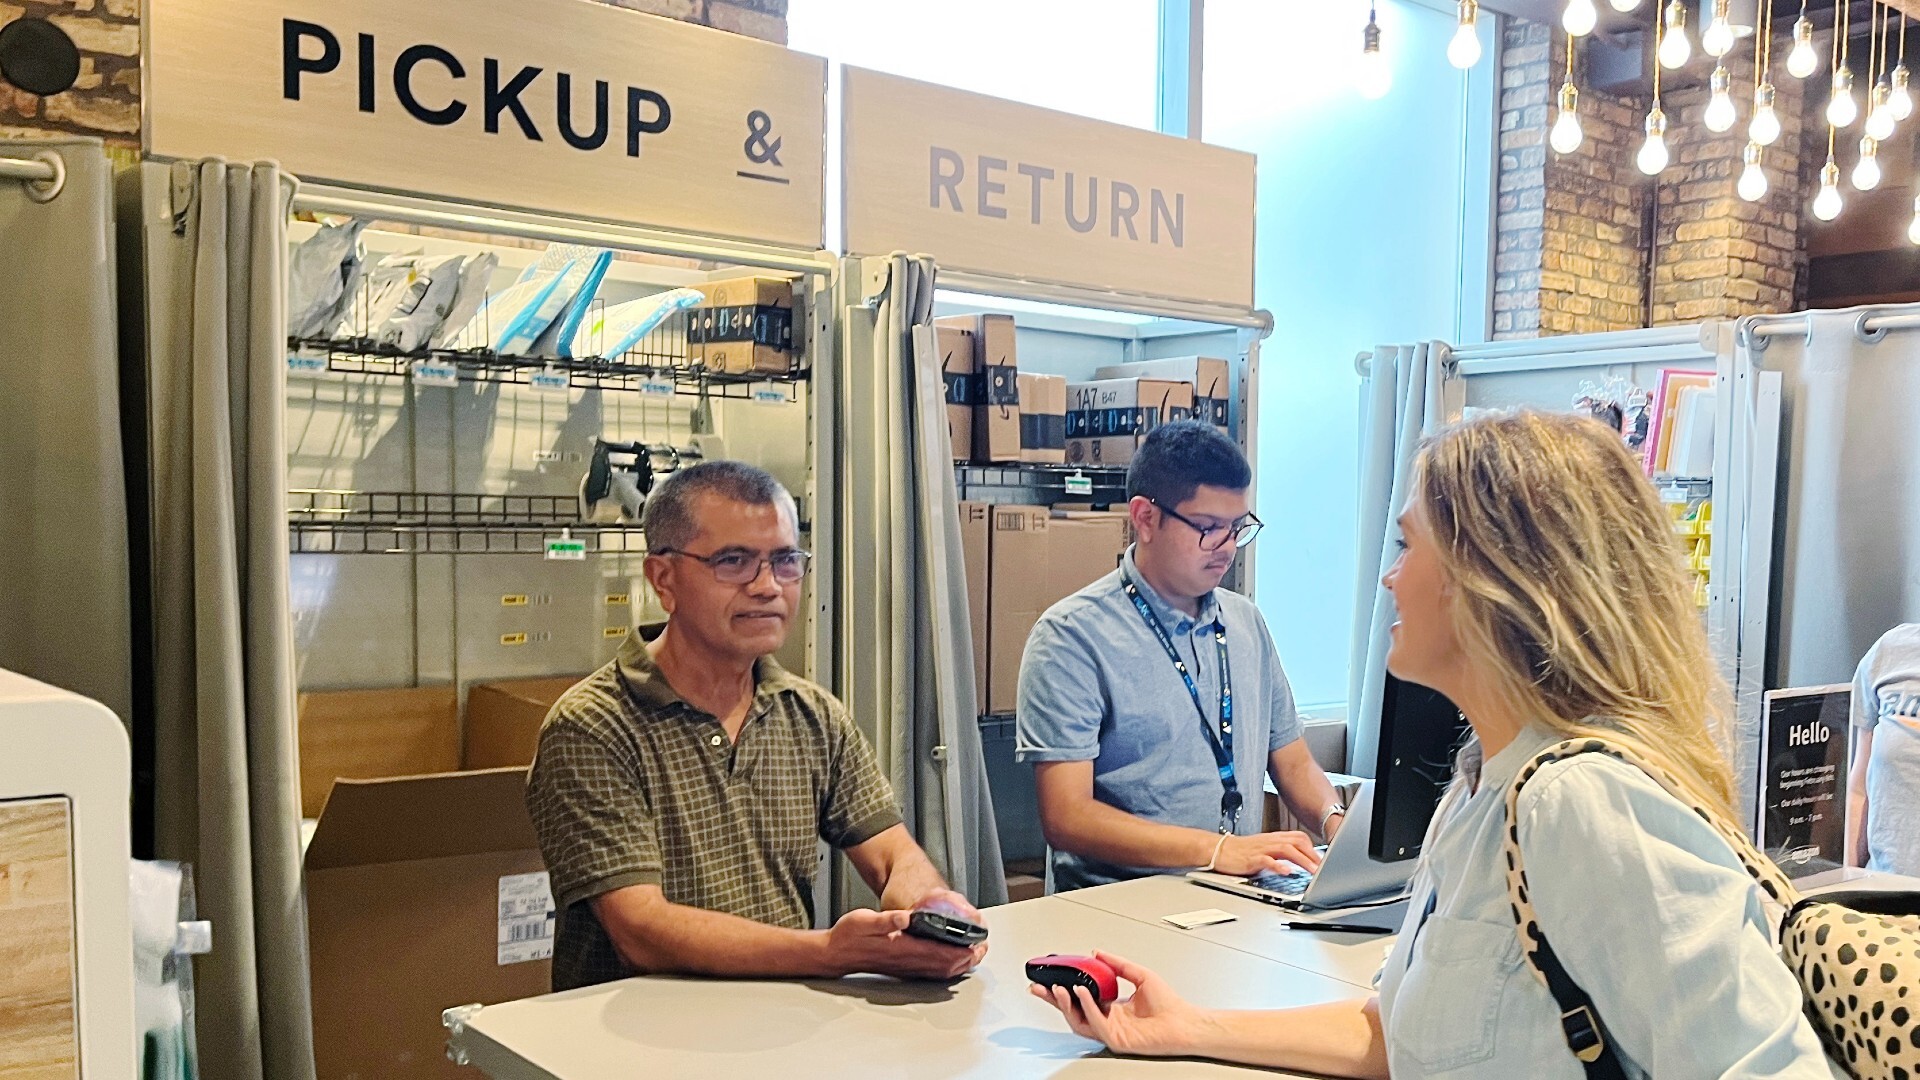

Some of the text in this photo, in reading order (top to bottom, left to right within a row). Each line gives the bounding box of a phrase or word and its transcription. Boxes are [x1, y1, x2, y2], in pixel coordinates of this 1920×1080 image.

[283, 18, 783, 167] PICKUP &
[929, 146, 1184, 248] RETURN
[1076, 388, 1097, 410] 1A7
[1789, 721, 1830, 746] Hello
